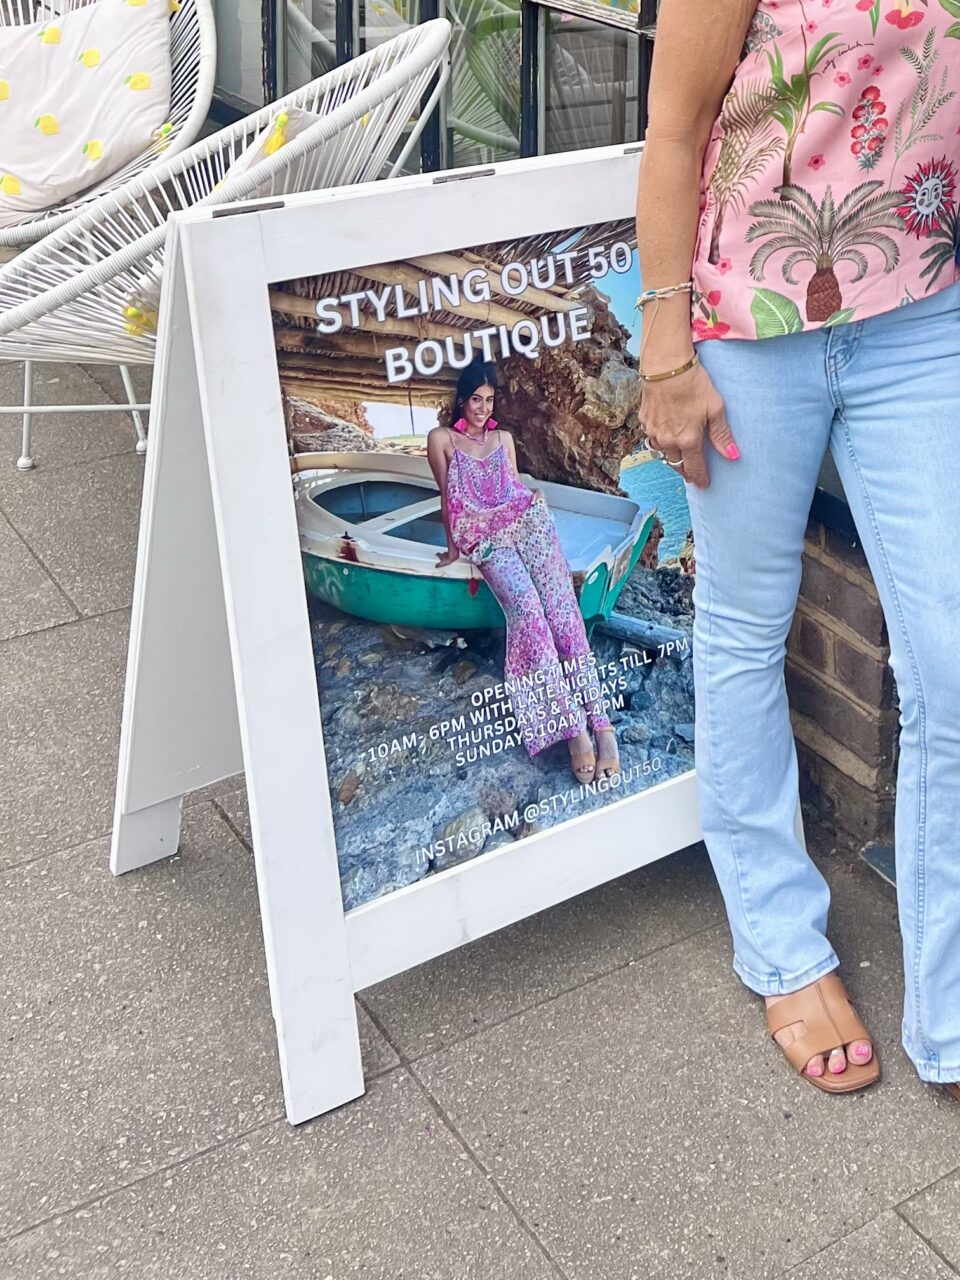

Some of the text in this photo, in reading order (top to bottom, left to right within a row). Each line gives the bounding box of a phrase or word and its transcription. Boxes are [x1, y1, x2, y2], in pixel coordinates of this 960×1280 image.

[316, 241, 632, 334] STYLING OUT 50
[385, 307, 592, 383] BOUTIQUE
[429, 715, 466, 740] 6PM
[470, 700, 513, 725] WITH
[516, 683, 556, 709] LATE
[559, 661, 617, 693] NIGHTS
[620, 651, 652, 671] TILL
[657, 637, 689, 658] 7PM
[447, 676, 628, 751] THURSDAYS & FRIDAYS
[471, 652, 597, 706] OPENING TIMES
[455, 728, 534, 767] SUNDAYS
[539, 712, 583, 737] 10AM
[416, 757, 662, 864] INSTAGRAM @STYLINGOUT50
